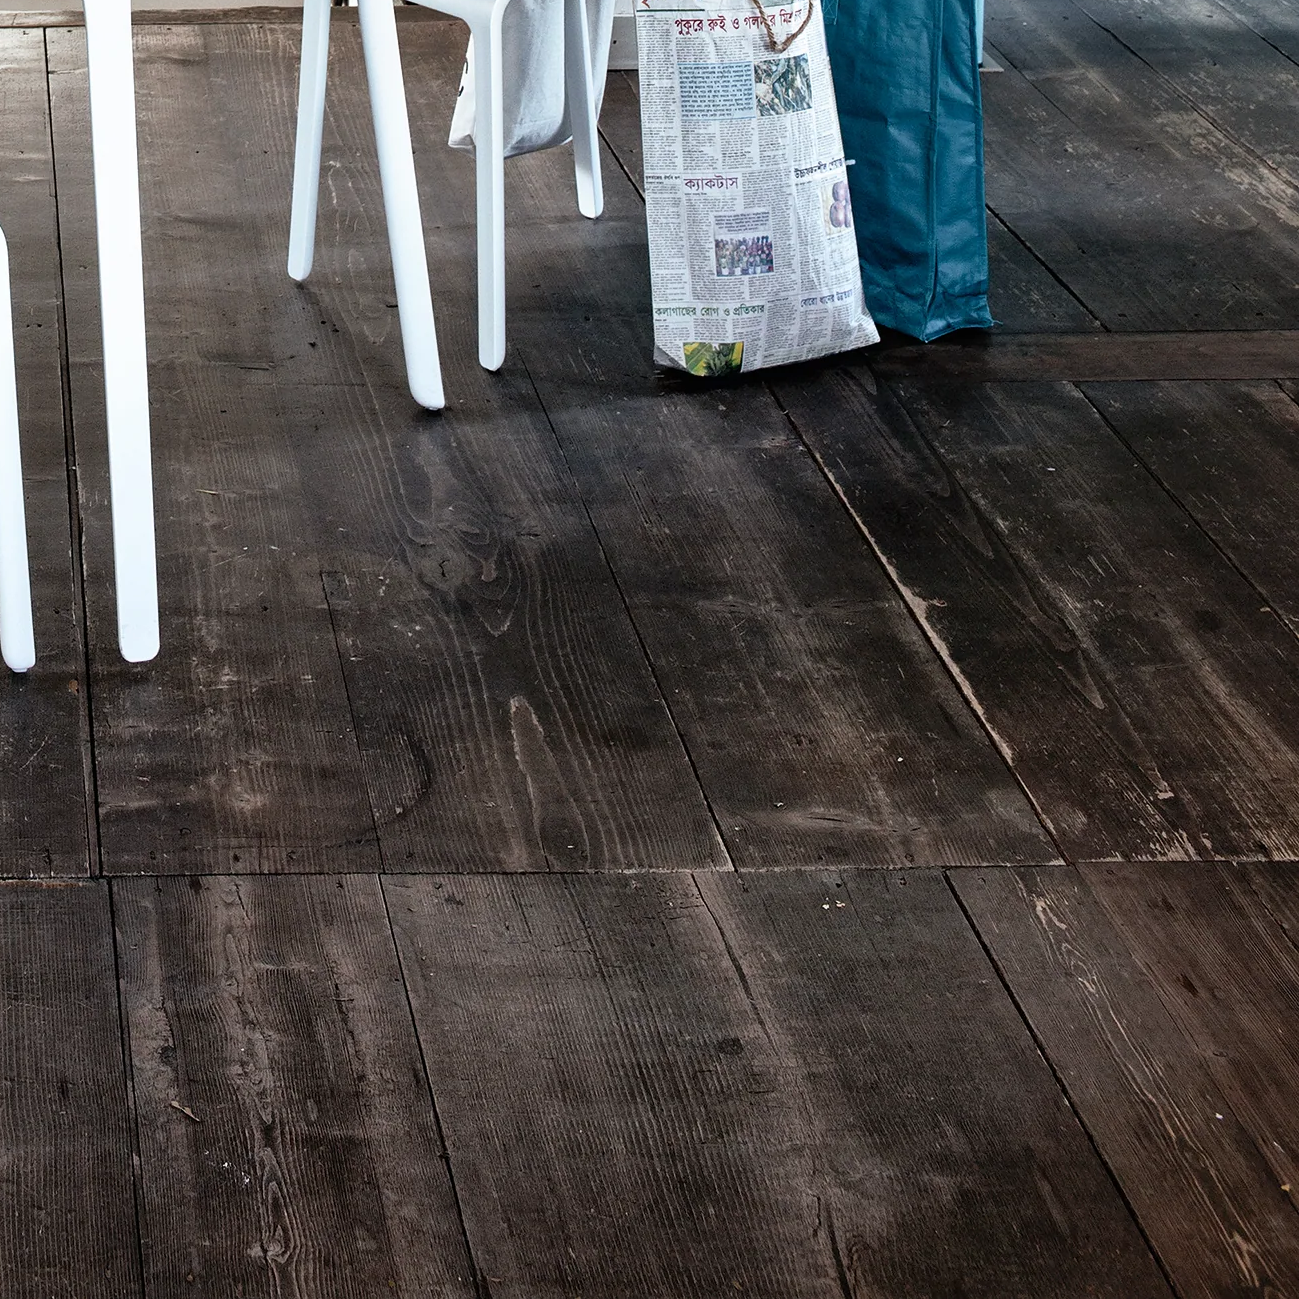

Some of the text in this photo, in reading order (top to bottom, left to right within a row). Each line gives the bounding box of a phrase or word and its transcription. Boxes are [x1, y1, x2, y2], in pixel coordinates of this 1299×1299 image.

[674, 18, 704, 36] পুকুরে
[706, 14, 727, 33] রুই
[732, 18, 740, 30] ও
[683, 174, 739, 191] ক্যাকটাস
[654, 303, 765, 316] কলাগাছের রোগ ও প্রতিকার
